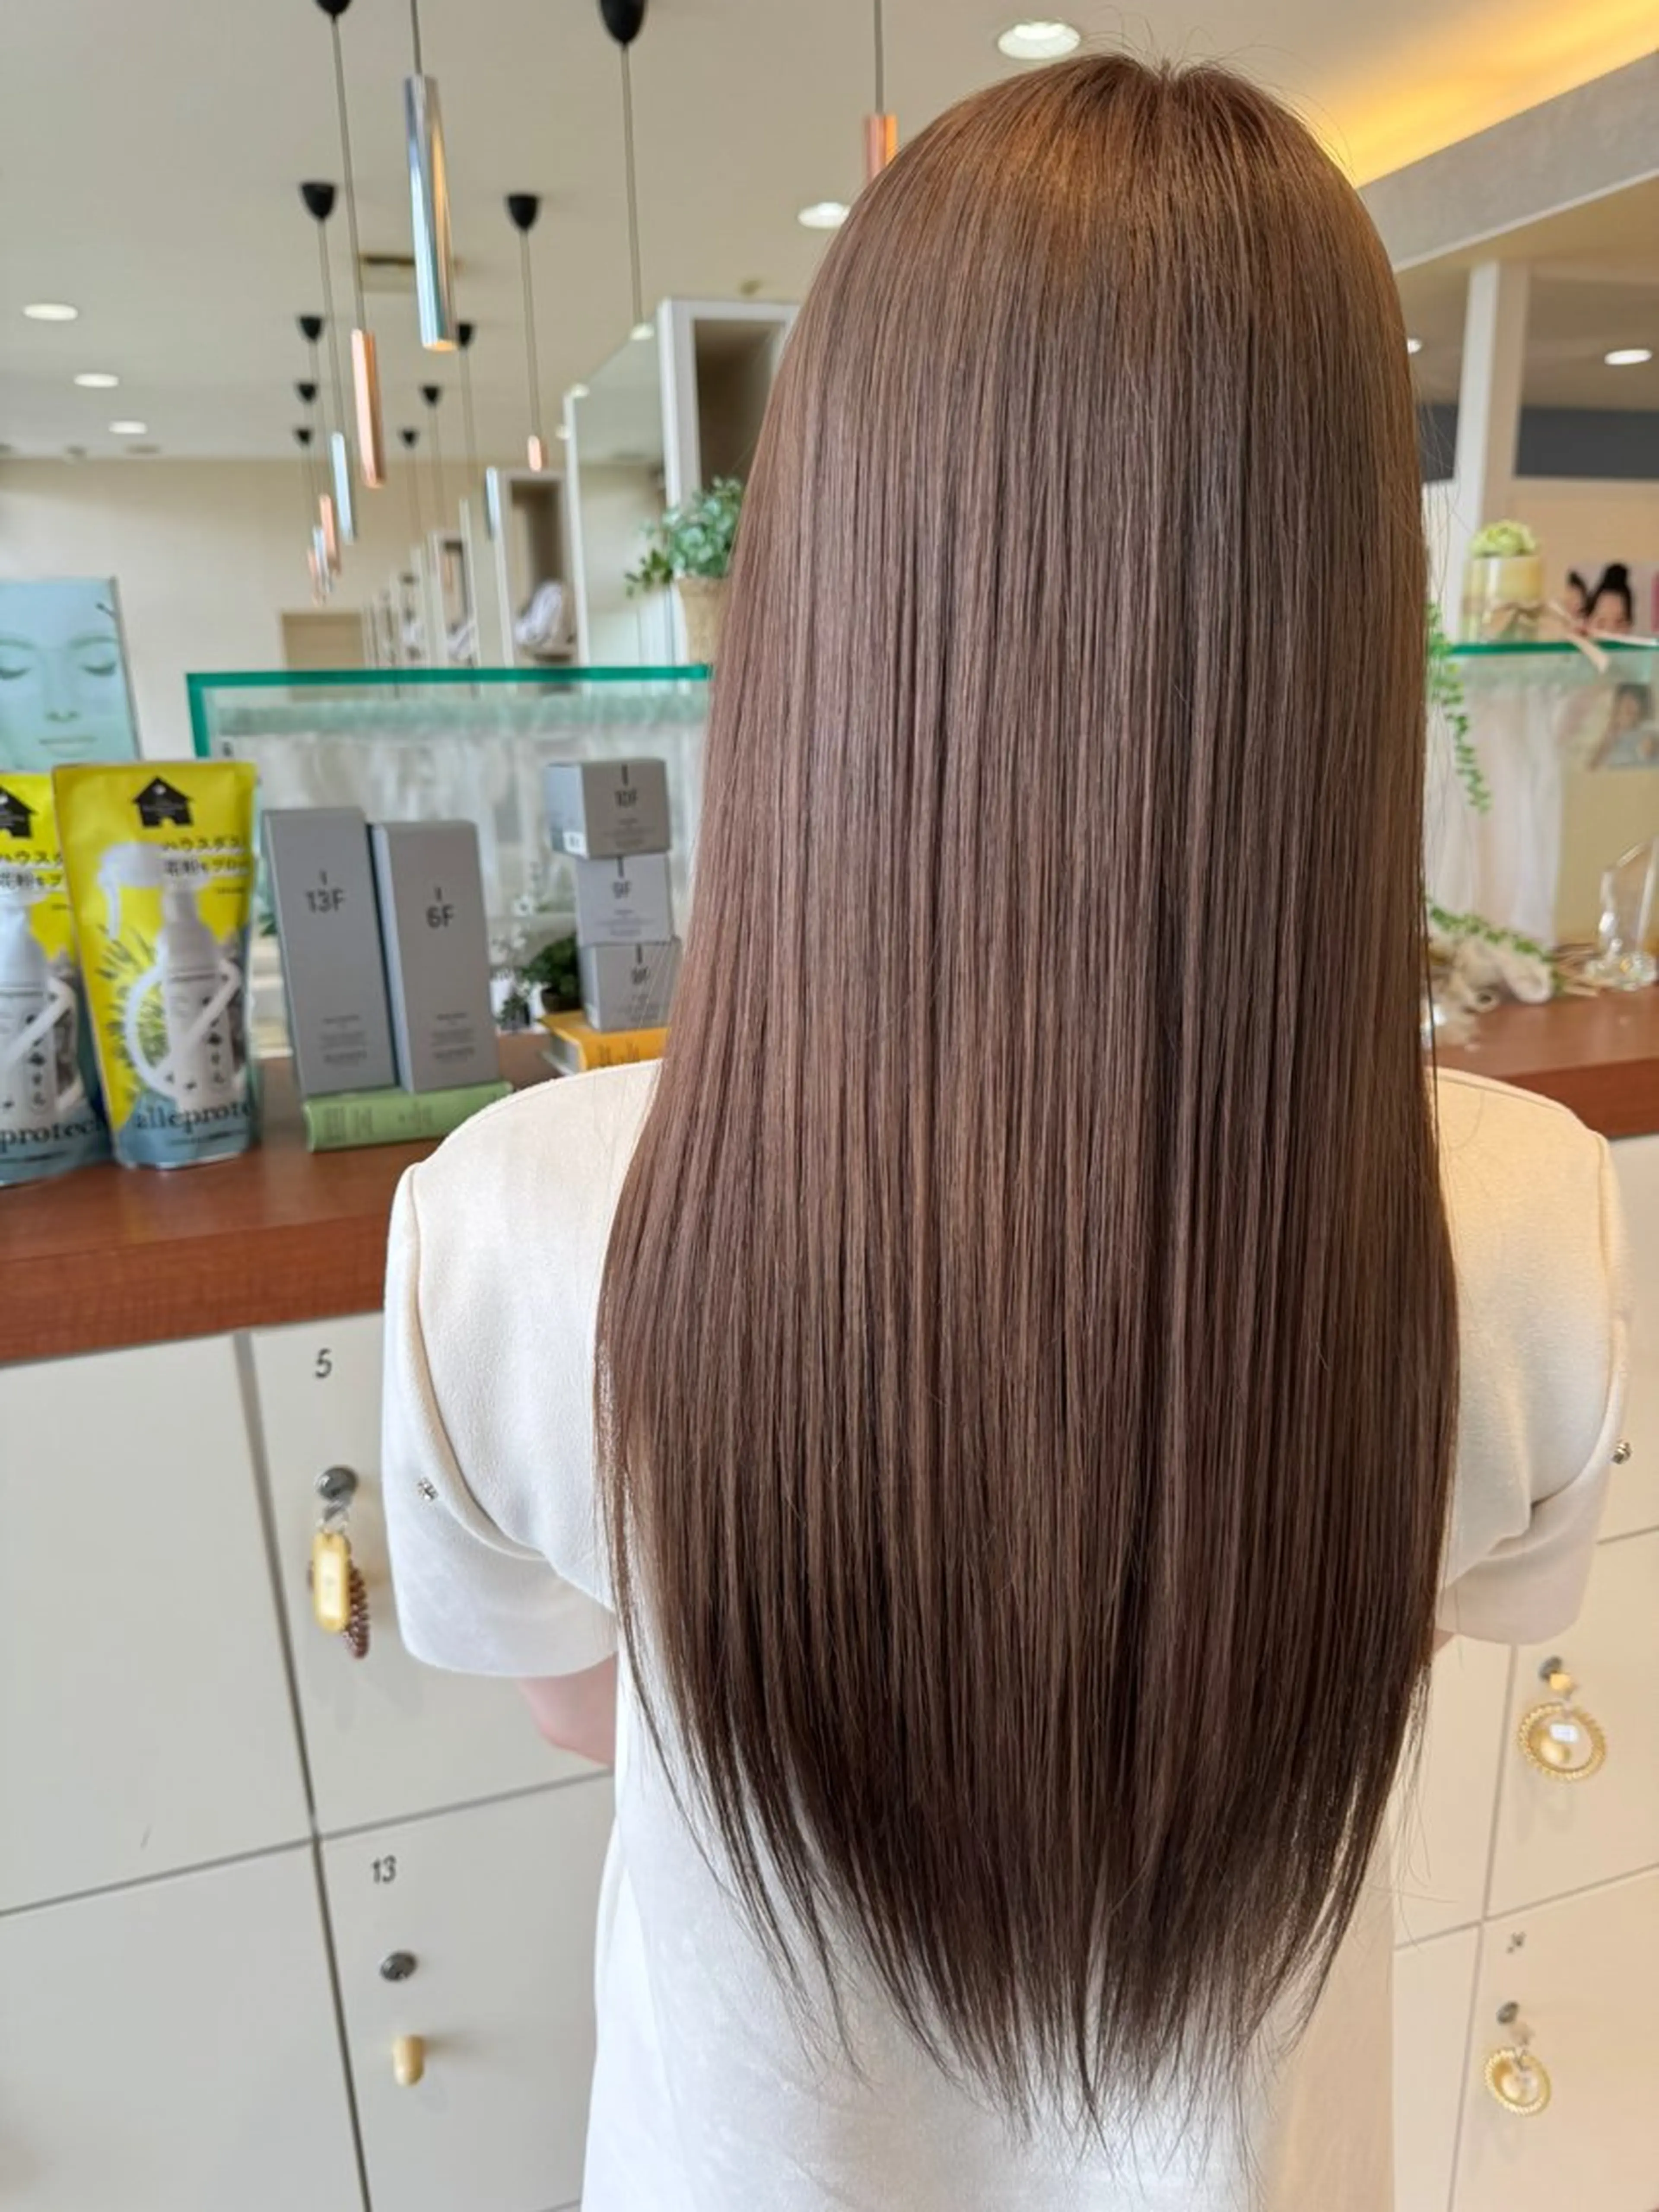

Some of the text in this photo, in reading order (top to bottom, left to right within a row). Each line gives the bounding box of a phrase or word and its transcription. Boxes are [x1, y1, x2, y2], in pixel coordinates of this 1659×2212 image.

[305, 887, 346, 913] 13F
[426, 904, 455, 930] 6F
[315, 1348, 333, 1379] 5
[372, 1854, 397, 1884] 13
